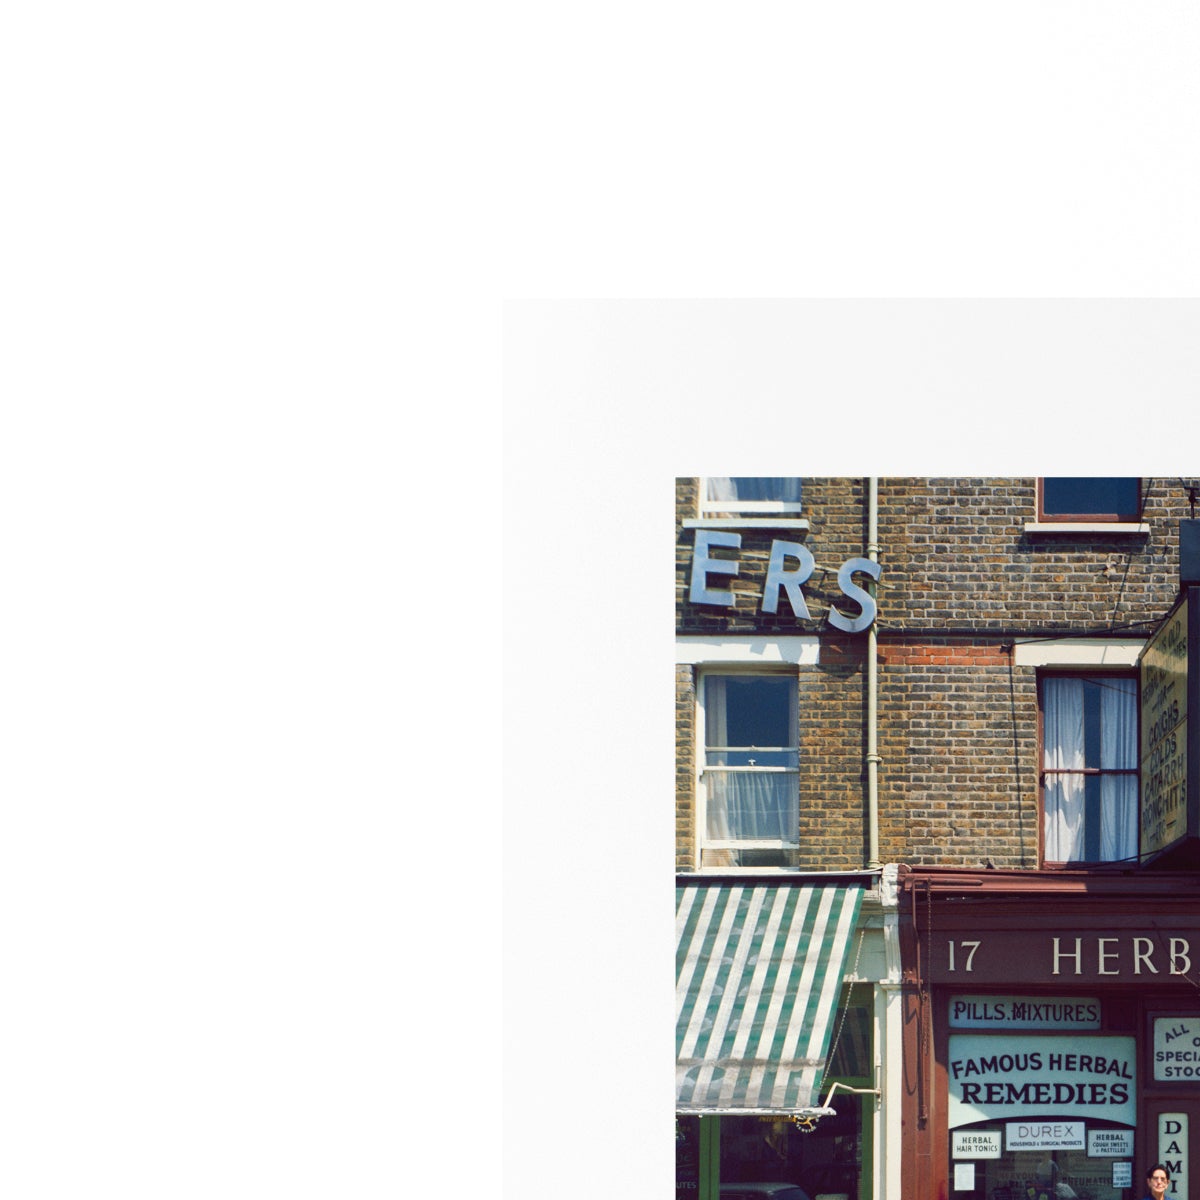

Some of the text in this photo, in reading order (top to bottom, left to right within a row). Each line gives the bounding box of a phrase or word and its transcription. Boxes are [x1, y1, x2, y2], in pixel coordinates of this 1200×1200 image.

[689, 529, 881, 633] ERS
[1150, 732, 1177, 777] COLDS
[1144, 752, 1184, 805] CATARRH
[948, 940, 981, 972] 17
[1164, 1024, 1190, 1043] ALL
[951, 1053, 1133, 1080] FAMOUS HERBAL
[960, 1083, 1129, 1104] REMEDIES
[962, 1136, 993, 1144] HERBAL
[1018, 1126, 1075, 1138] DUREX
[956, 1144, 998, 1153] HAIR TONICS
